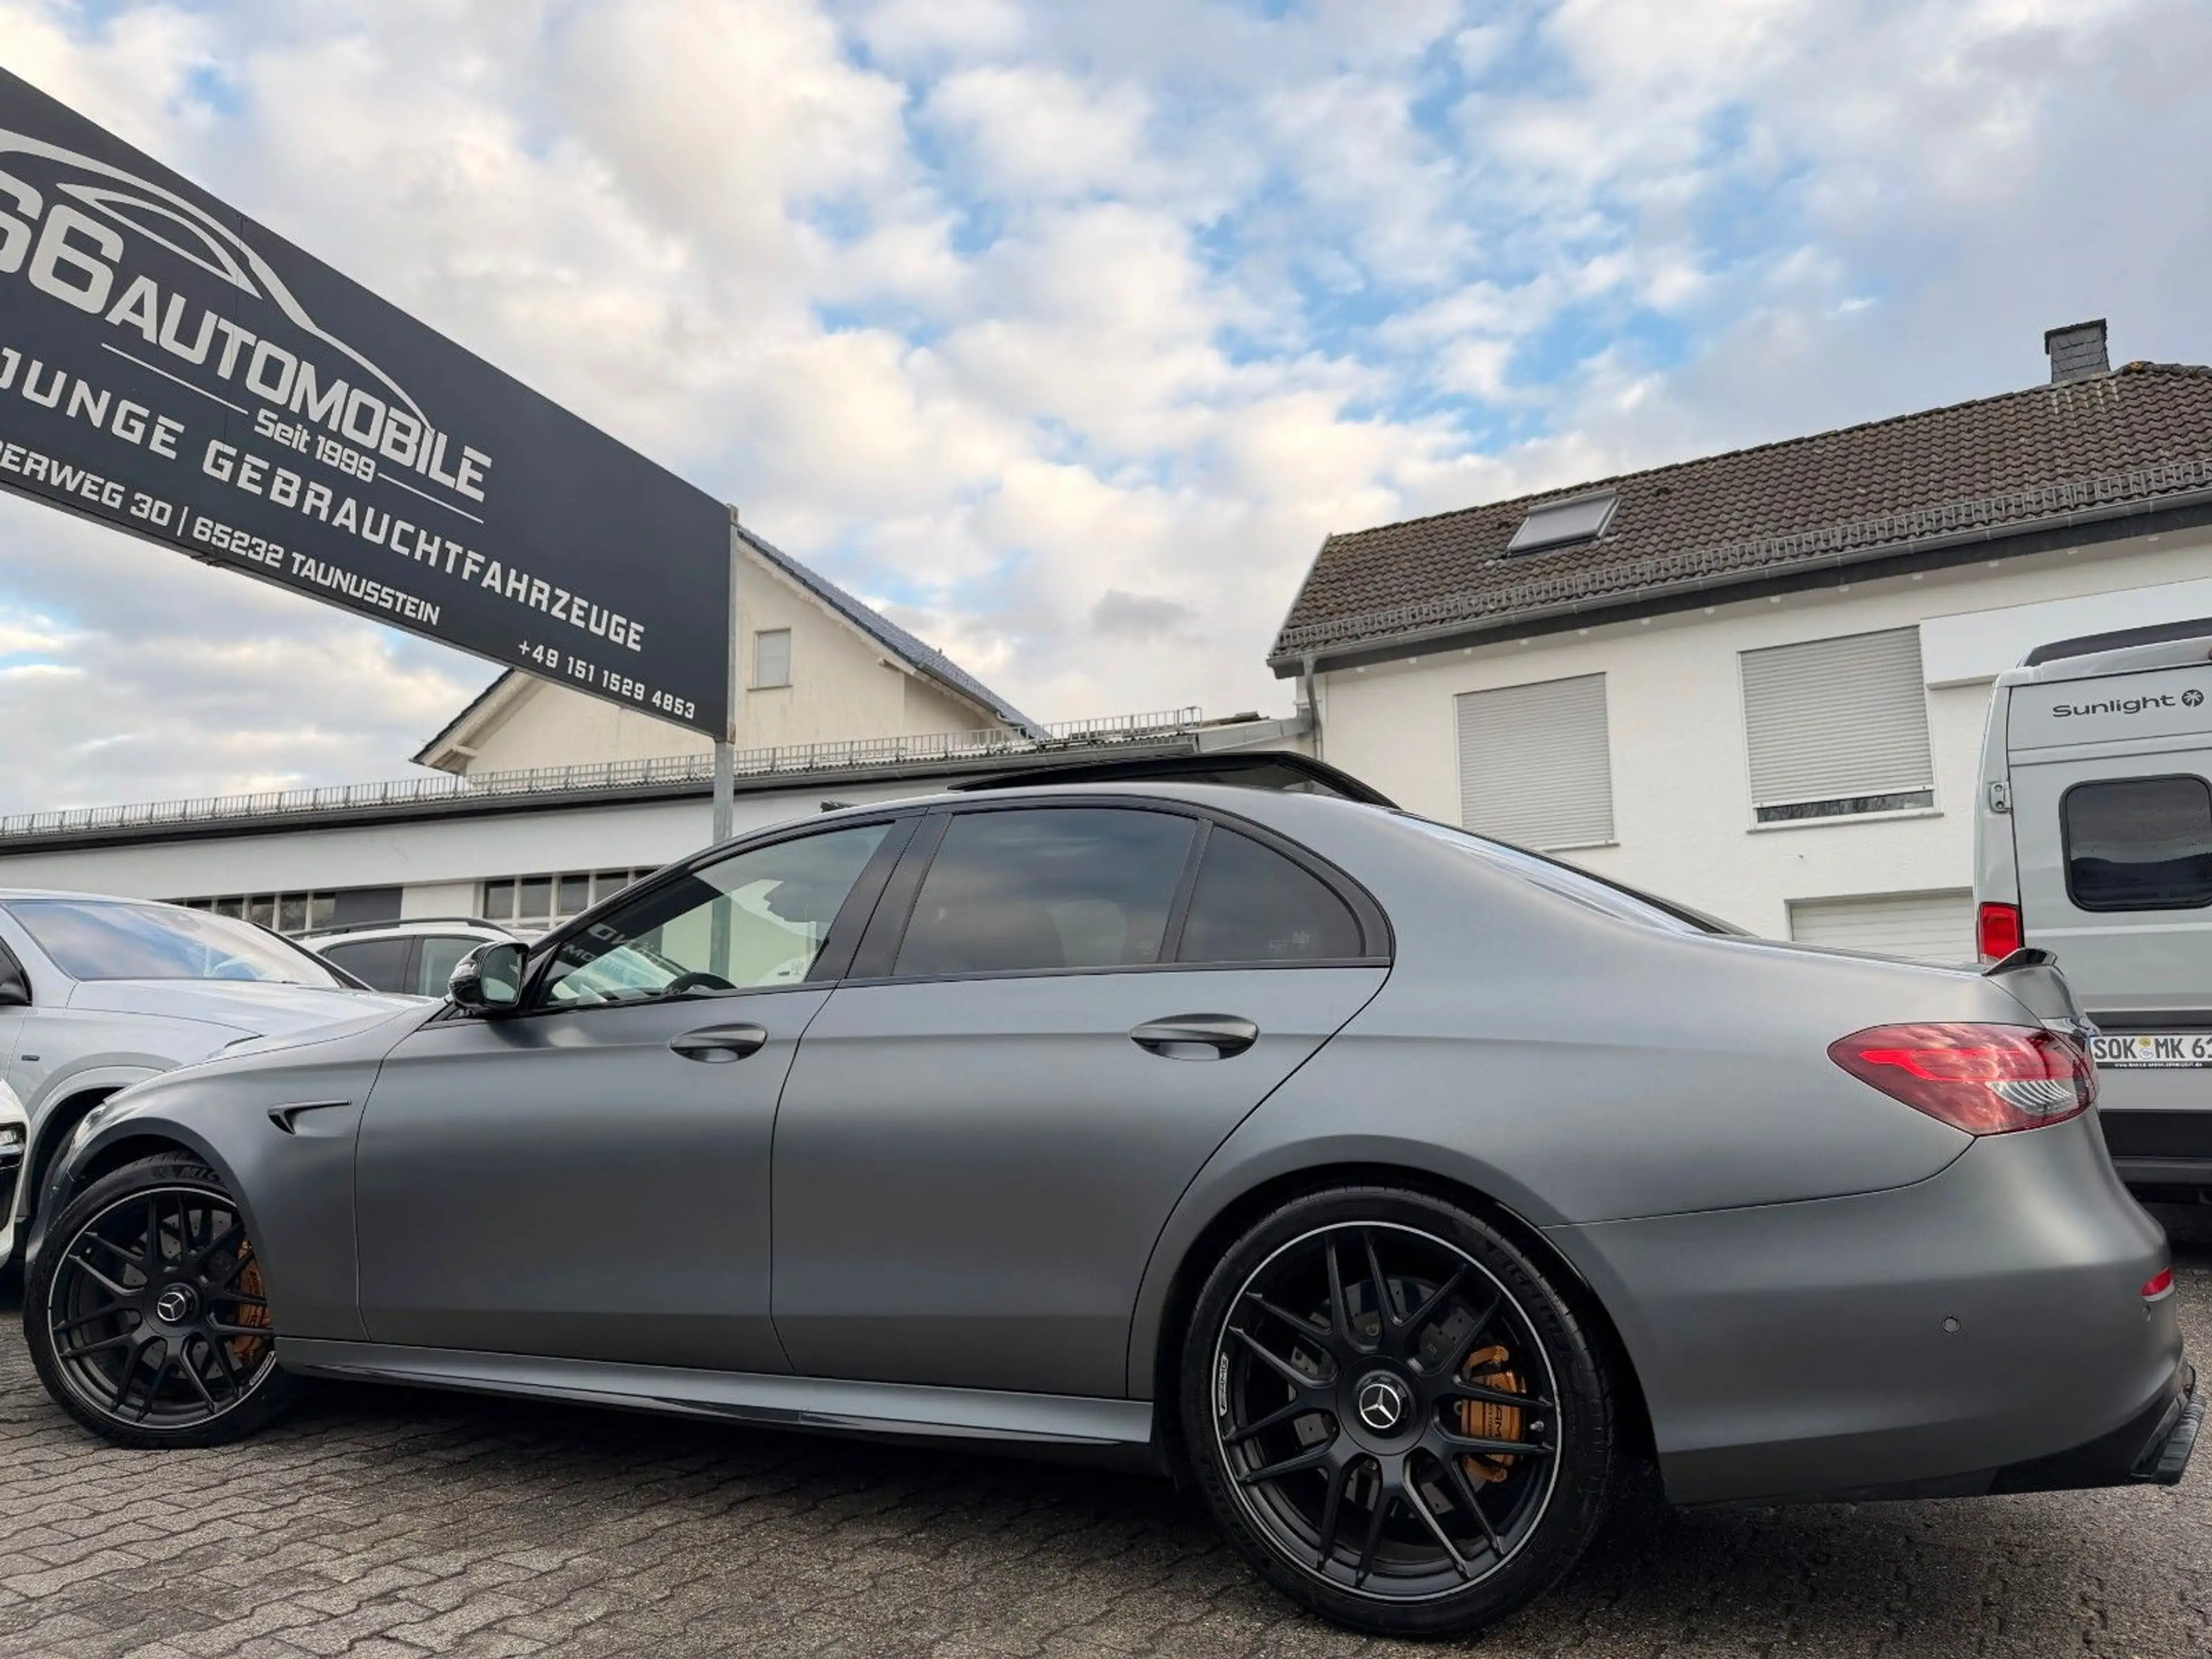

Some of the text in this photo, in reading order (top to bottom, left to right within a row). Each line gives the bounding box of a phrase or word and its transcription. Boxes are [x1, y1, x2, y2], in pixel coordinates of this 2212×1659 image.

[254, 408, 376, 483] Seit 1999
[0, 347, 645, 652] JUNGE GEBRAUCHTFAHRZEUGE
[0, 440, 126, 509] ERWEG
[130, 492, 172, 527] 30
[192, 516, 285, 568] 65232
[291, 551, 440, 626] TAUNUSSTEIN
[518, 641, 695, 719] +49 151 1529 4853
[2052, 695, 2176, 718] Sunlight
[2093, 1038, 2137, 1059] SOK
[2154, 1038, 2185, 1058] MK
